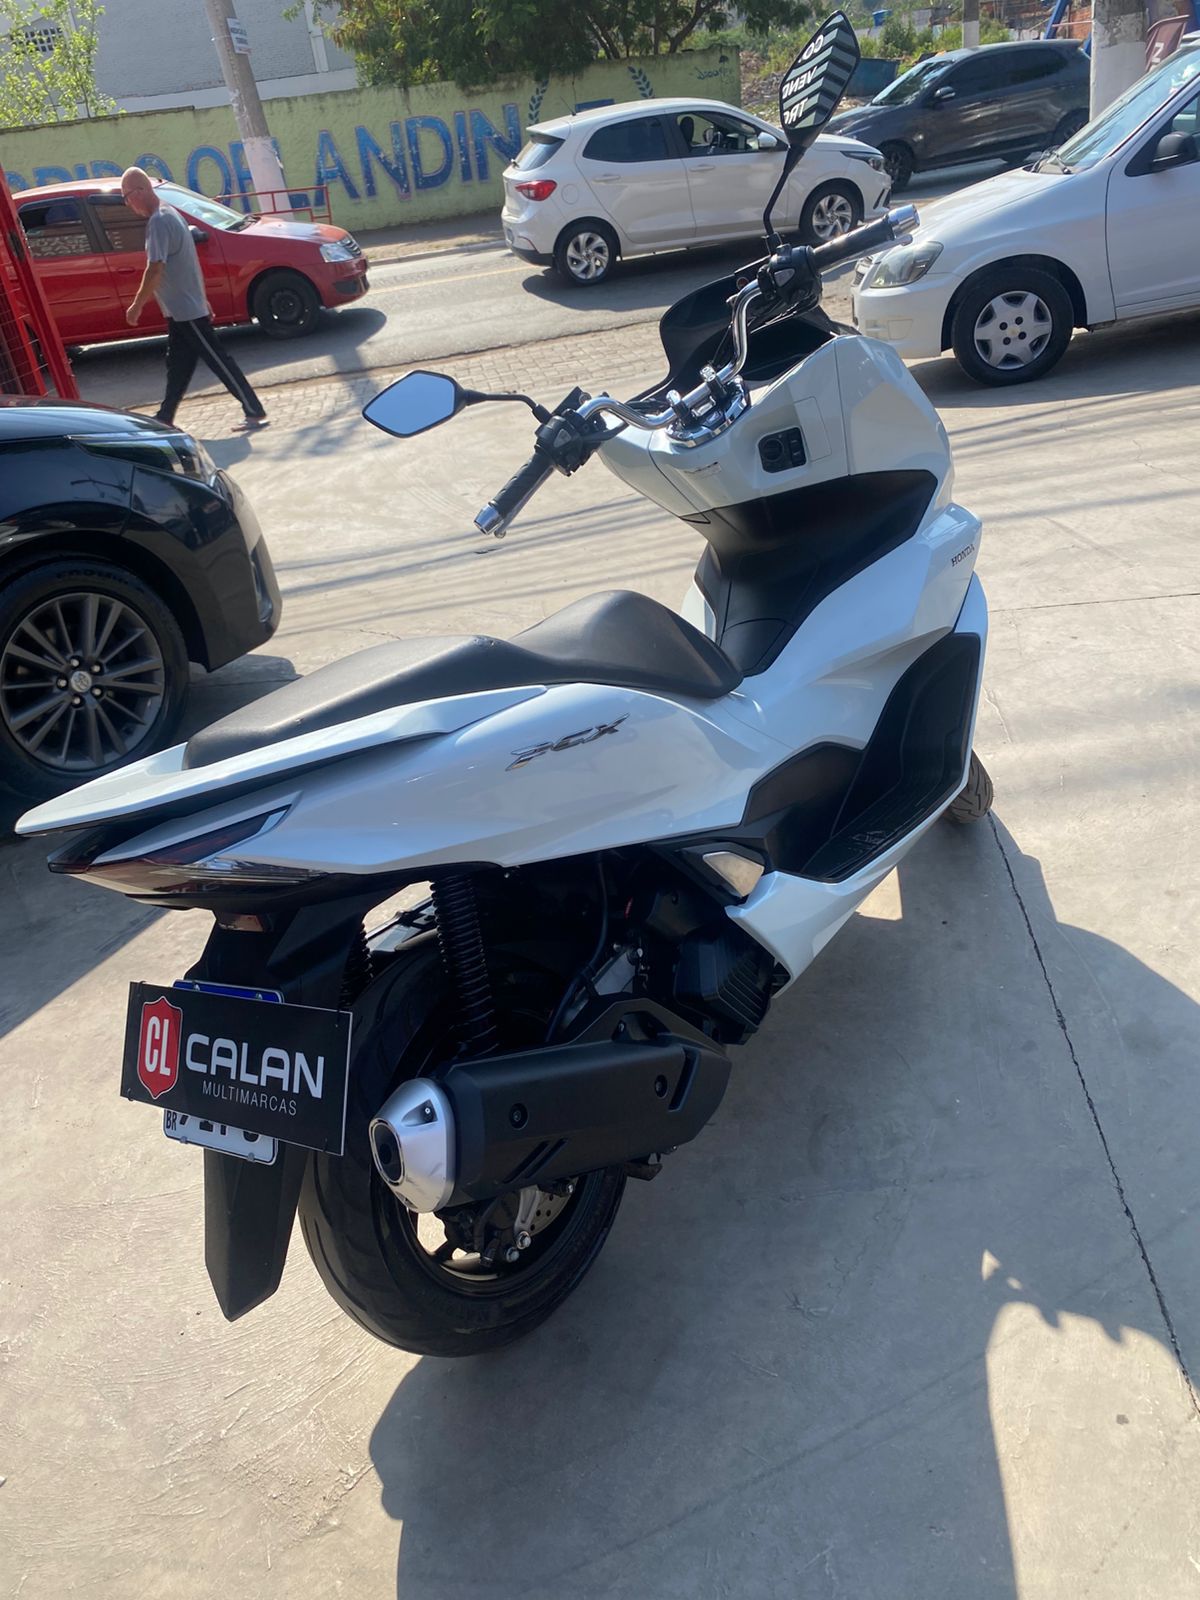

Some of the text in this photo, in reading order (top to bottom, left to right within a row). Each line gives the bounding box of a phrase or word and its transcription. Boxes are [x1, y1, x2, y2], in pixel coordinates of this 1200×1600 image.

[951, 544, 975, 567] HONDA
[505, 713, 630, 771] PCX
[144, 1016, 172, 1076] CL
[185, 1033, 325, 1099] CALAN
[165, 1110, 178, 1132] BR
[202, 1080, 297, 1116] MULTIMARCAS
